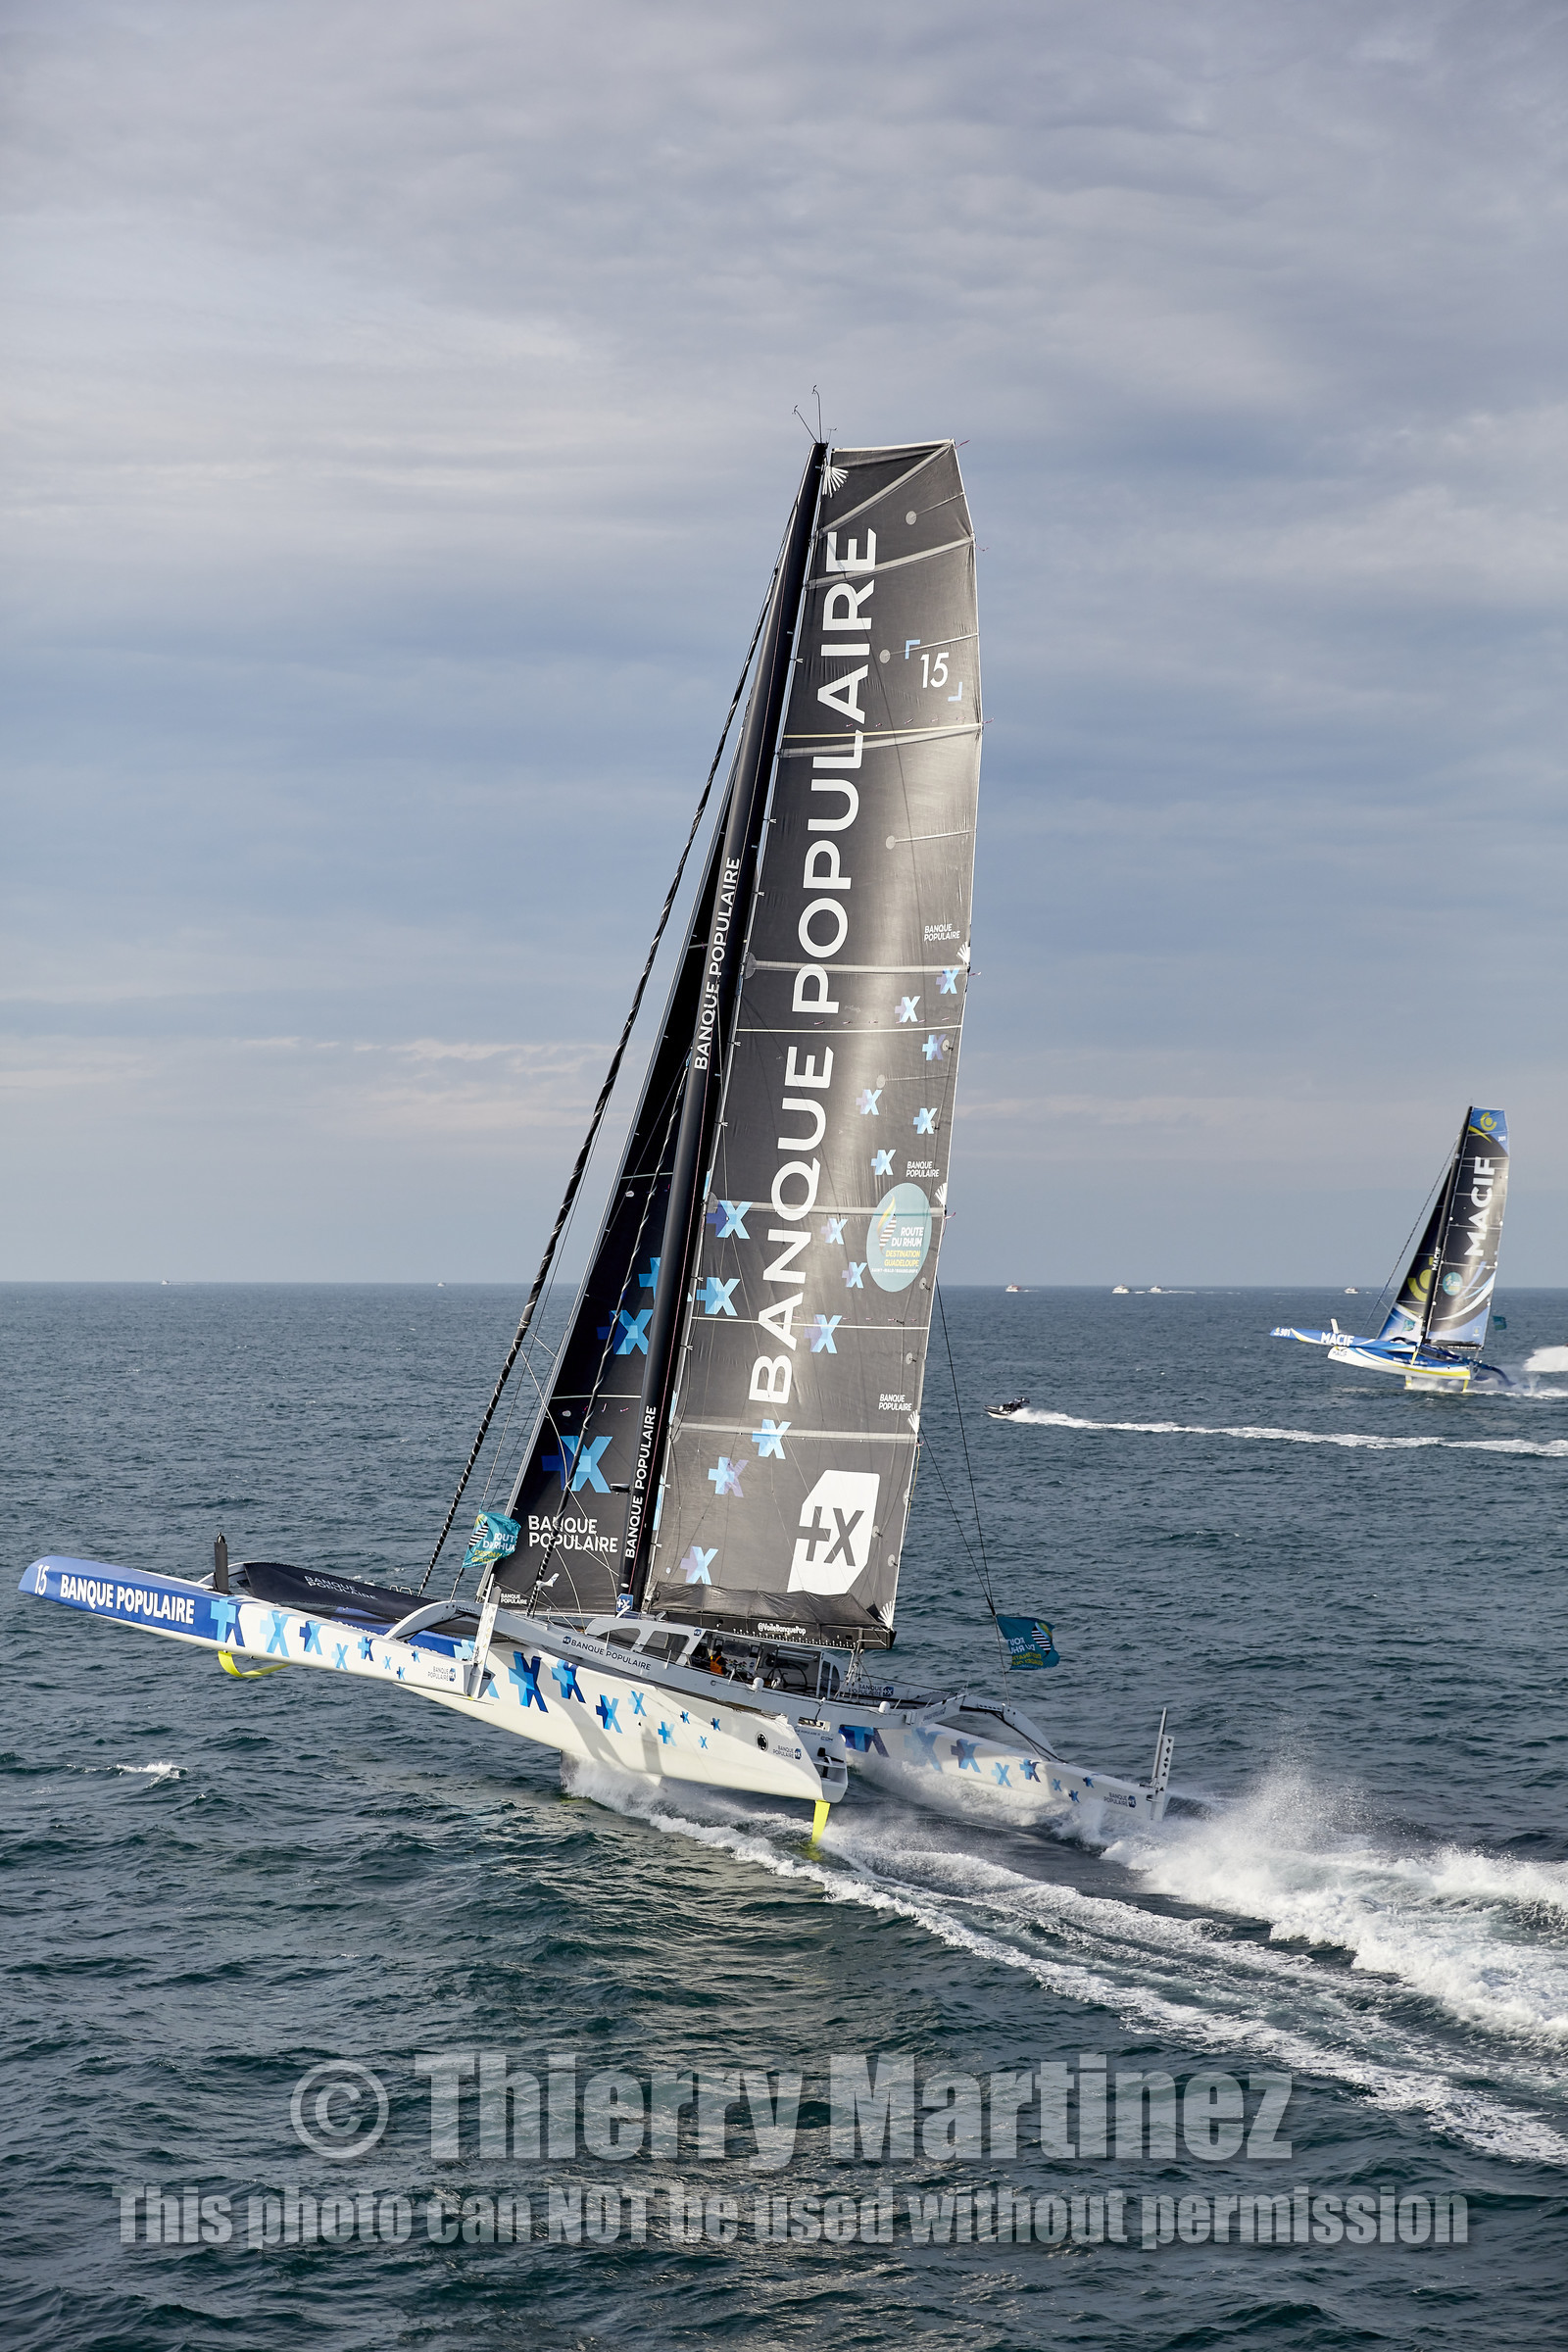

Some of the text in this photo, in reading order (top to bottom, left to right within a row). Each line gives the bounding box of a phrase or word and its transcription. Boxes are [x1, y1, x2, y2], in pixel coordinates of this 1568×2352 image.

[919, 652, 950, 689] 15
[924, 923, 953, 934] BANQUE
[924, 931, 960, 942] POPULAIRE
[694, 857, 740, 1070] BANQUE POPULAIRE
[749, 527, 877, 1403] BANQUE POPULAIRE
[906, 1161, 932, 1170] BANQUE
[1464, 1156, 1494, 1256] MACIF
[901, 1227, 924, 1237] ROUTE
[891, 1238, 923, 1247] DU RHUM
[885, 1250, 921, 1258] DESTINATION
[1320, 1332, 1354, 1347] MACIF
[879, 1393, 906, 1402] BANQUE
[878, 1401, 912, 1411] POPULAIRE
[625, 1405, 657, 1559] BANQUE POPULAIRE
[529, 1532, 618, 1553] POPULAIRE
[34, 1564, 50, 1596] 15
[304, 1575, 356, 1591] BANQUE
[308, 1581, 378, 1600] POPULAIRE
[60, 1574, 195, 1625] BANQUE POPULAIRE
[758, 1622, 807, 1636] @VoileBanquePop
[571, 1639, 652, 1671] BANQUE POPULAIRE
